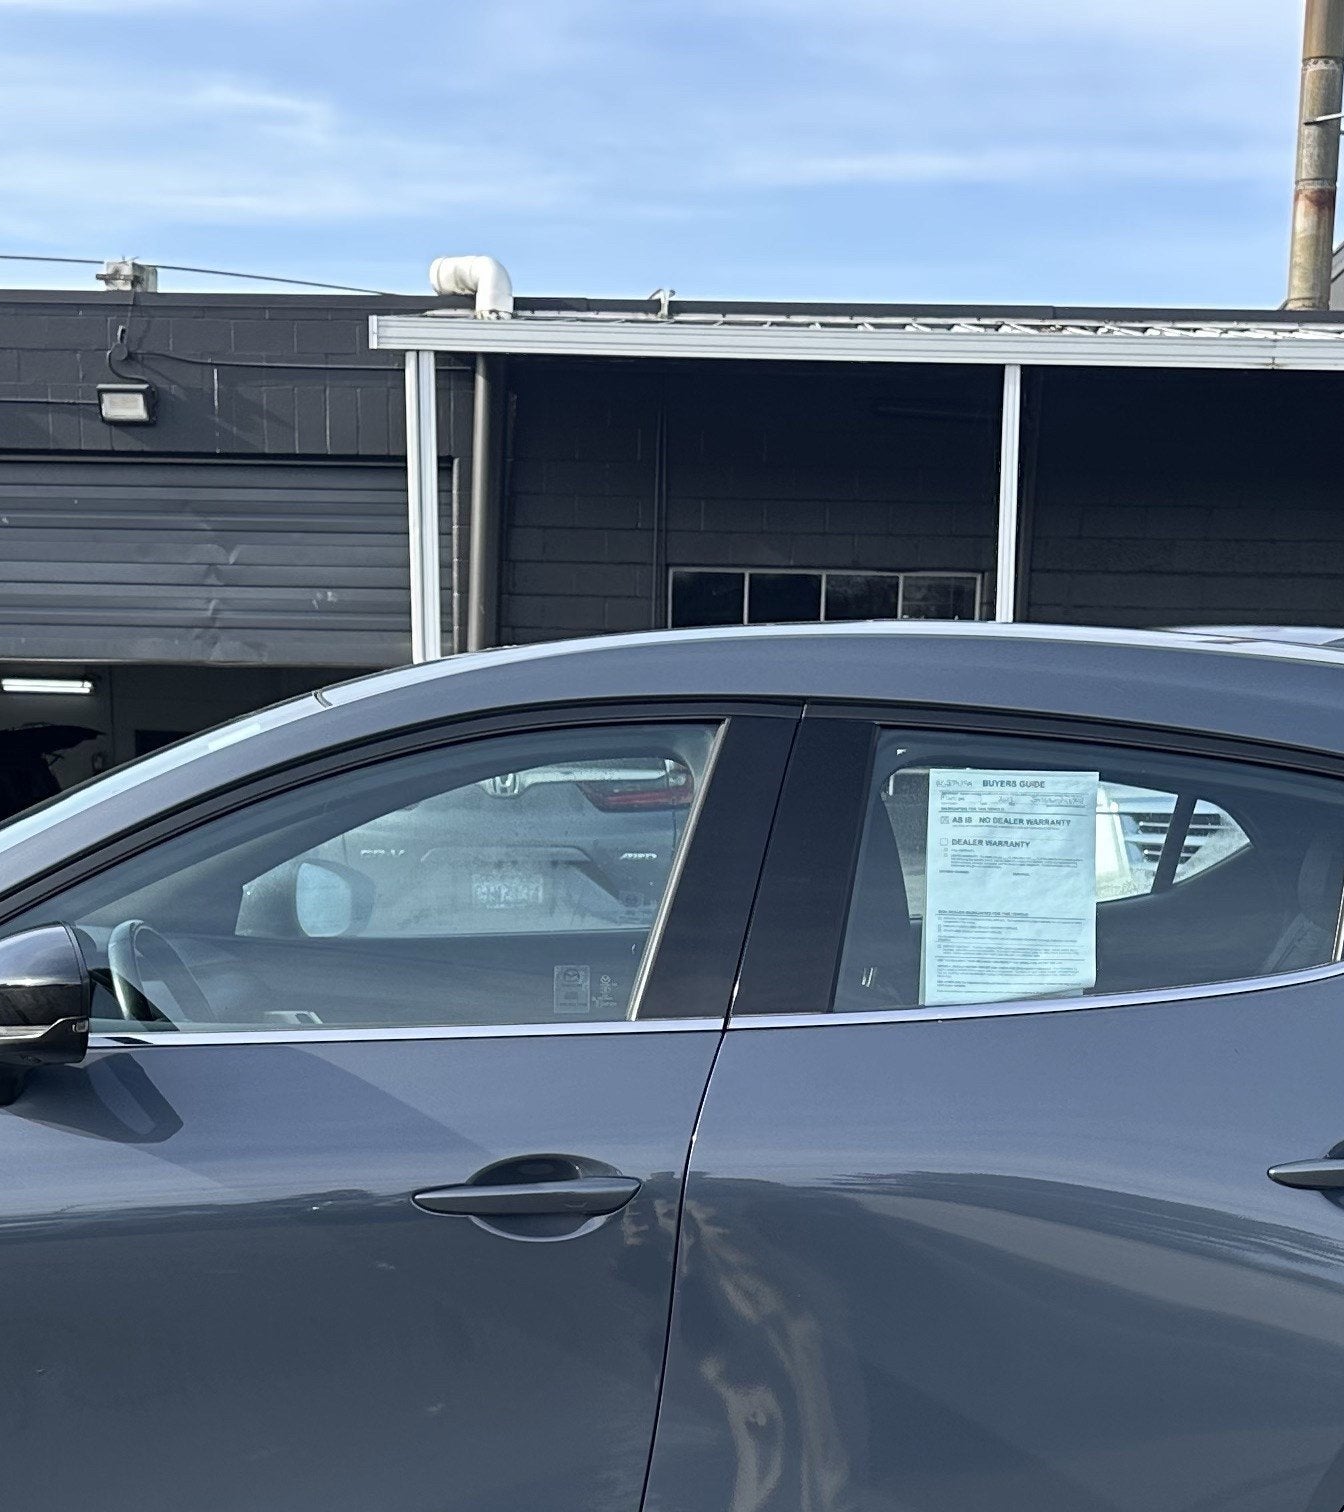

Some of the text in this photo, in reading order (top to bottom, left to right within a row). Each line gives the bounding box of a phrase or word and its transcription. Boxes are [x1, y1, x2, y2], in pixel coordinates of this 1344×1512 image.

[982, 779, 1017, 788] BUYERS
[1019, 780, 1046, 788] GUIDE
[992, 817, 1024, 825] DEALER
[1026, 818, 1071, 826] WARRANTY
[951, 838, 1031, 848] DEALER WARRANTY
